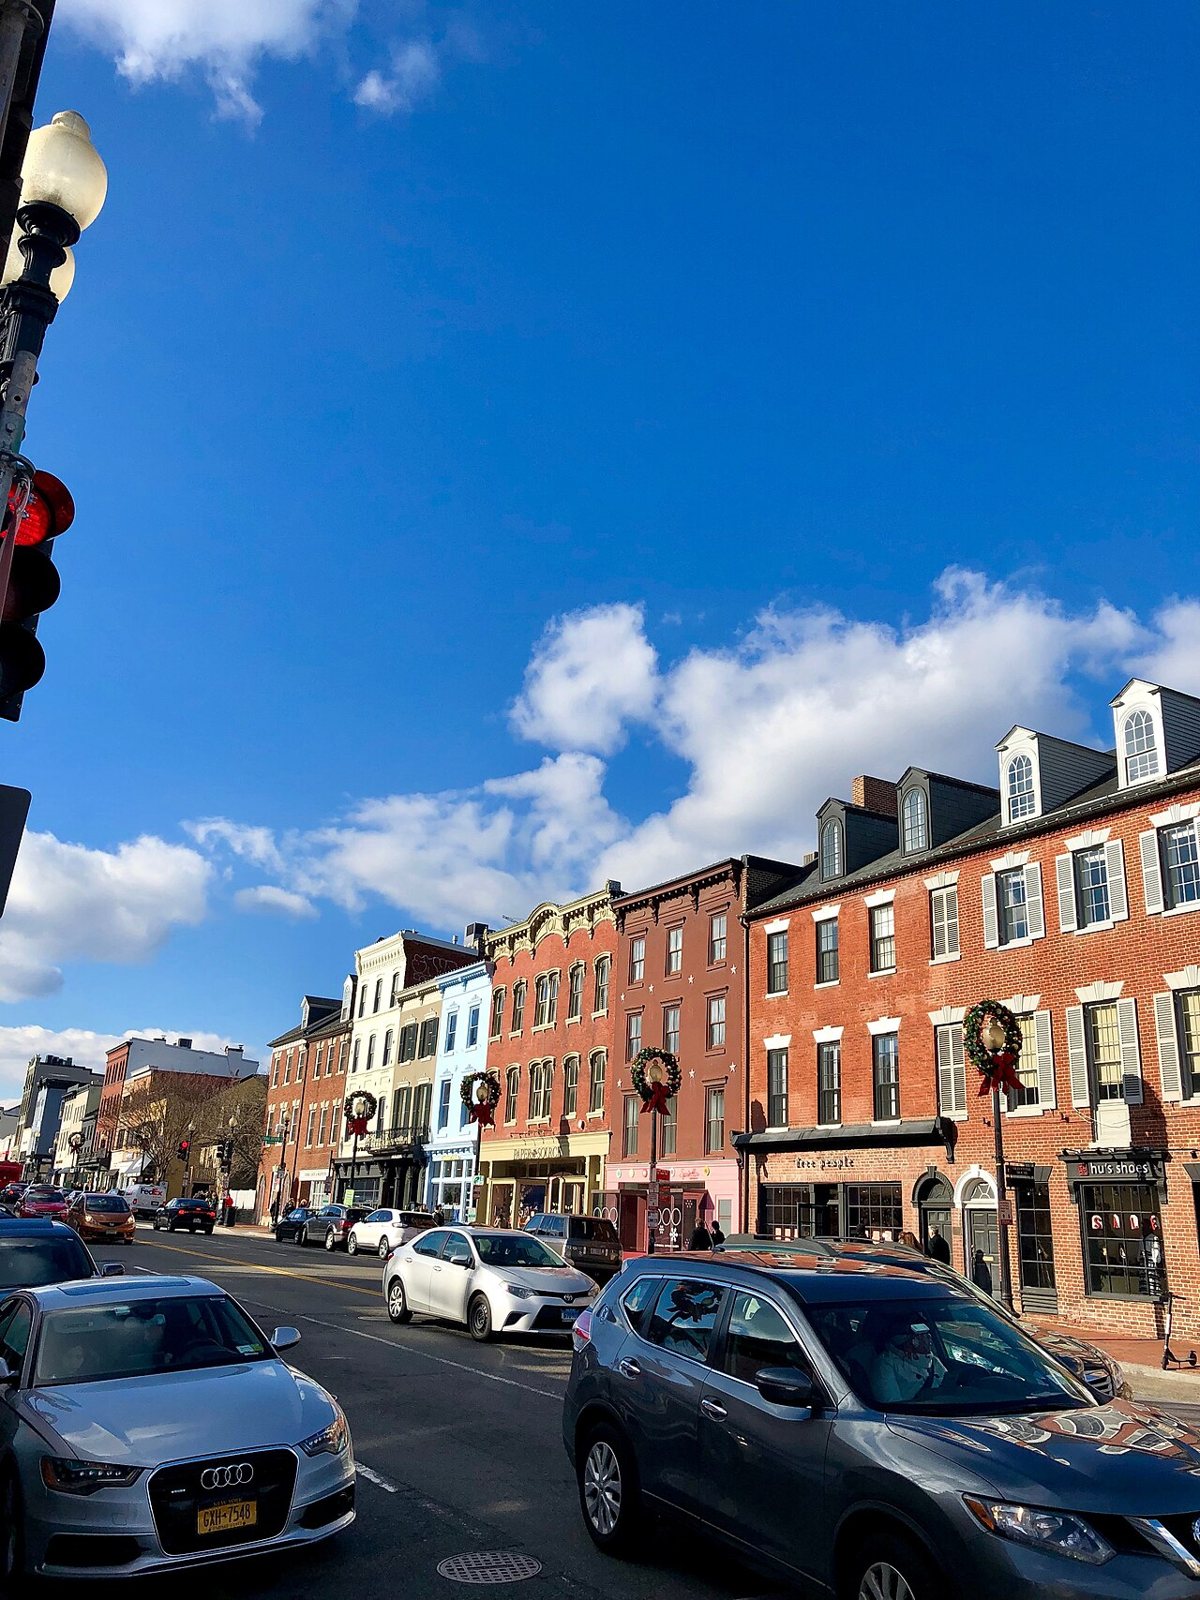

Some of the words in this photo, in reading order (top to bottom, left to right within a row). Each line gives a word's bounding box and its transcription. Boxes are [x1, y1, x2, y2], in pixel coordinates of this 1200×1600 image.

[820, 1156, 854, 1171] people
[1090, 1163, 1112, 1174] hu's
[1117, 1162, 1147, 1174] shoes
[140, 1187, 163, 1196] FedEx
[1091, 1214, 1158, 1231] SALE
